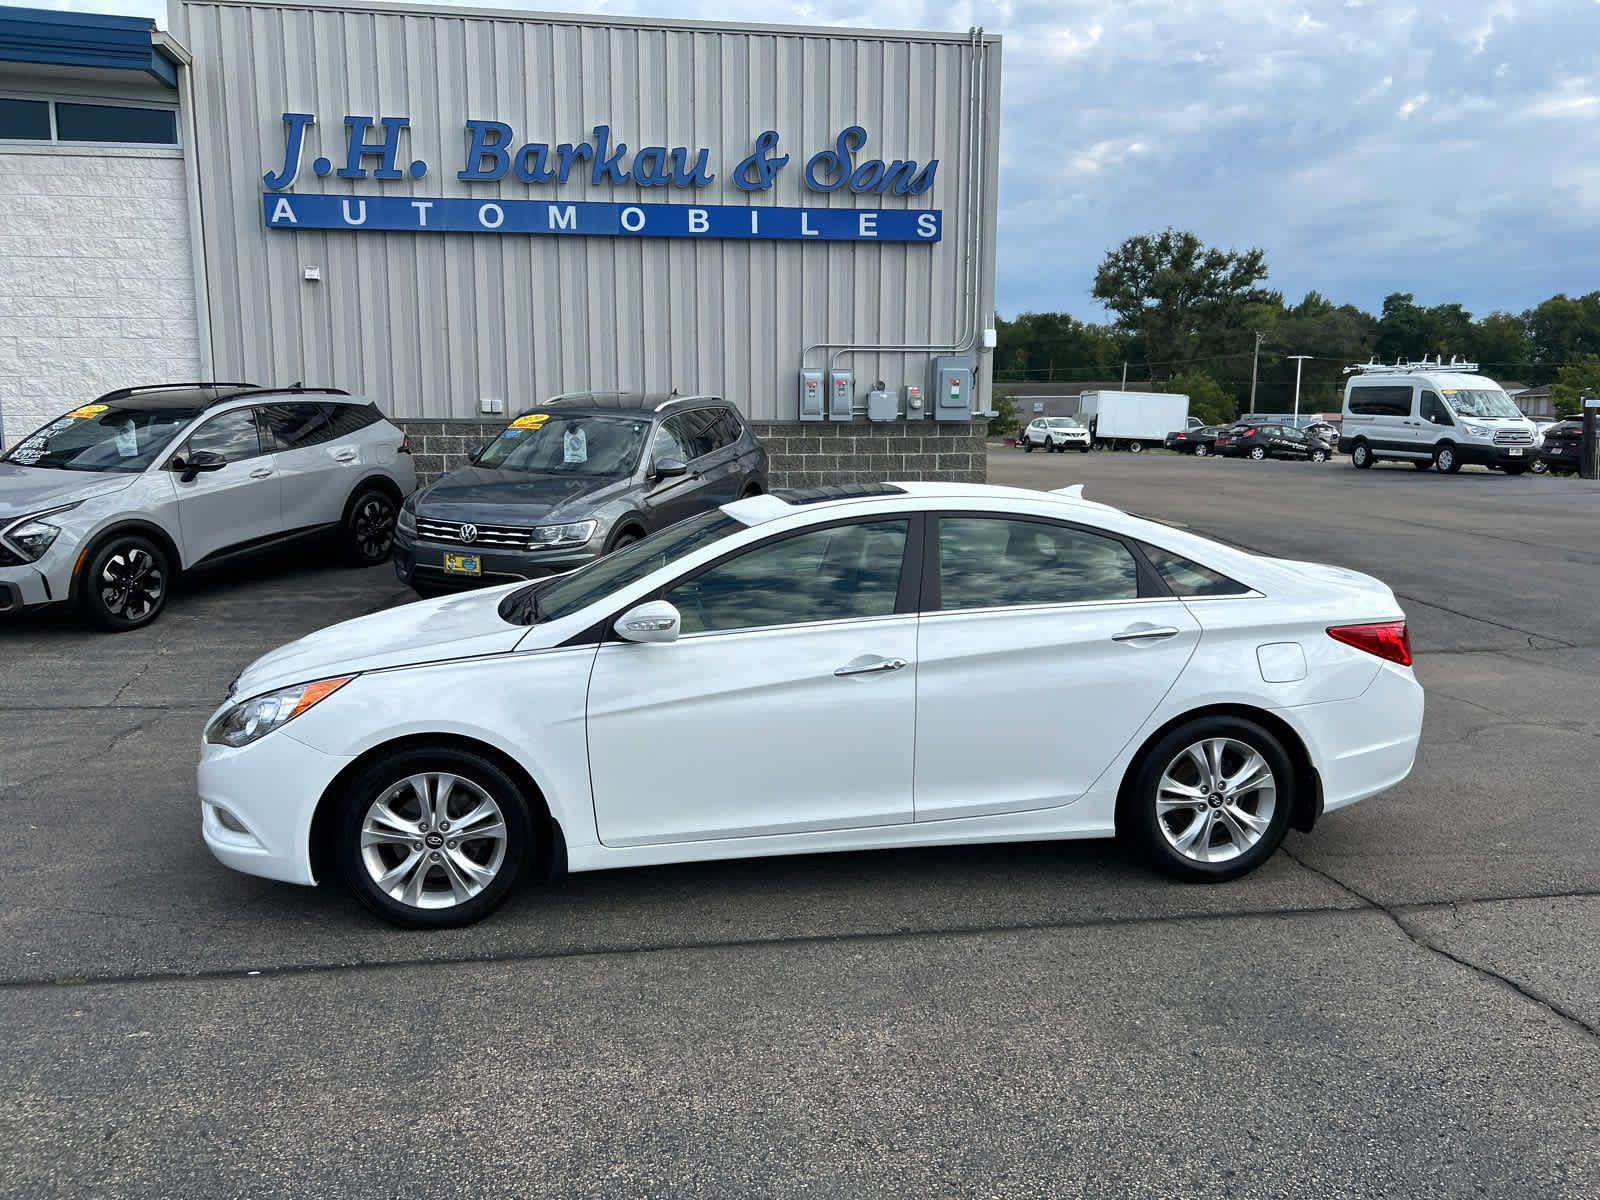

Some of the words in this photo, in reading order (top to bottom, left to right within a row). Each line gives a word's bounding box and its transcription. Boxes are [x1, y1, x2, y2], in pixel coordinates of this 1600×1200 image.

[263, 112, 428, 191] J.H.
[457, 119, 716, 188] Barkau
[733, 130, 790, 191] &
[805, 125, 940, 196] Sons
[271, 197, 938, 238] AUTOMOBILES
